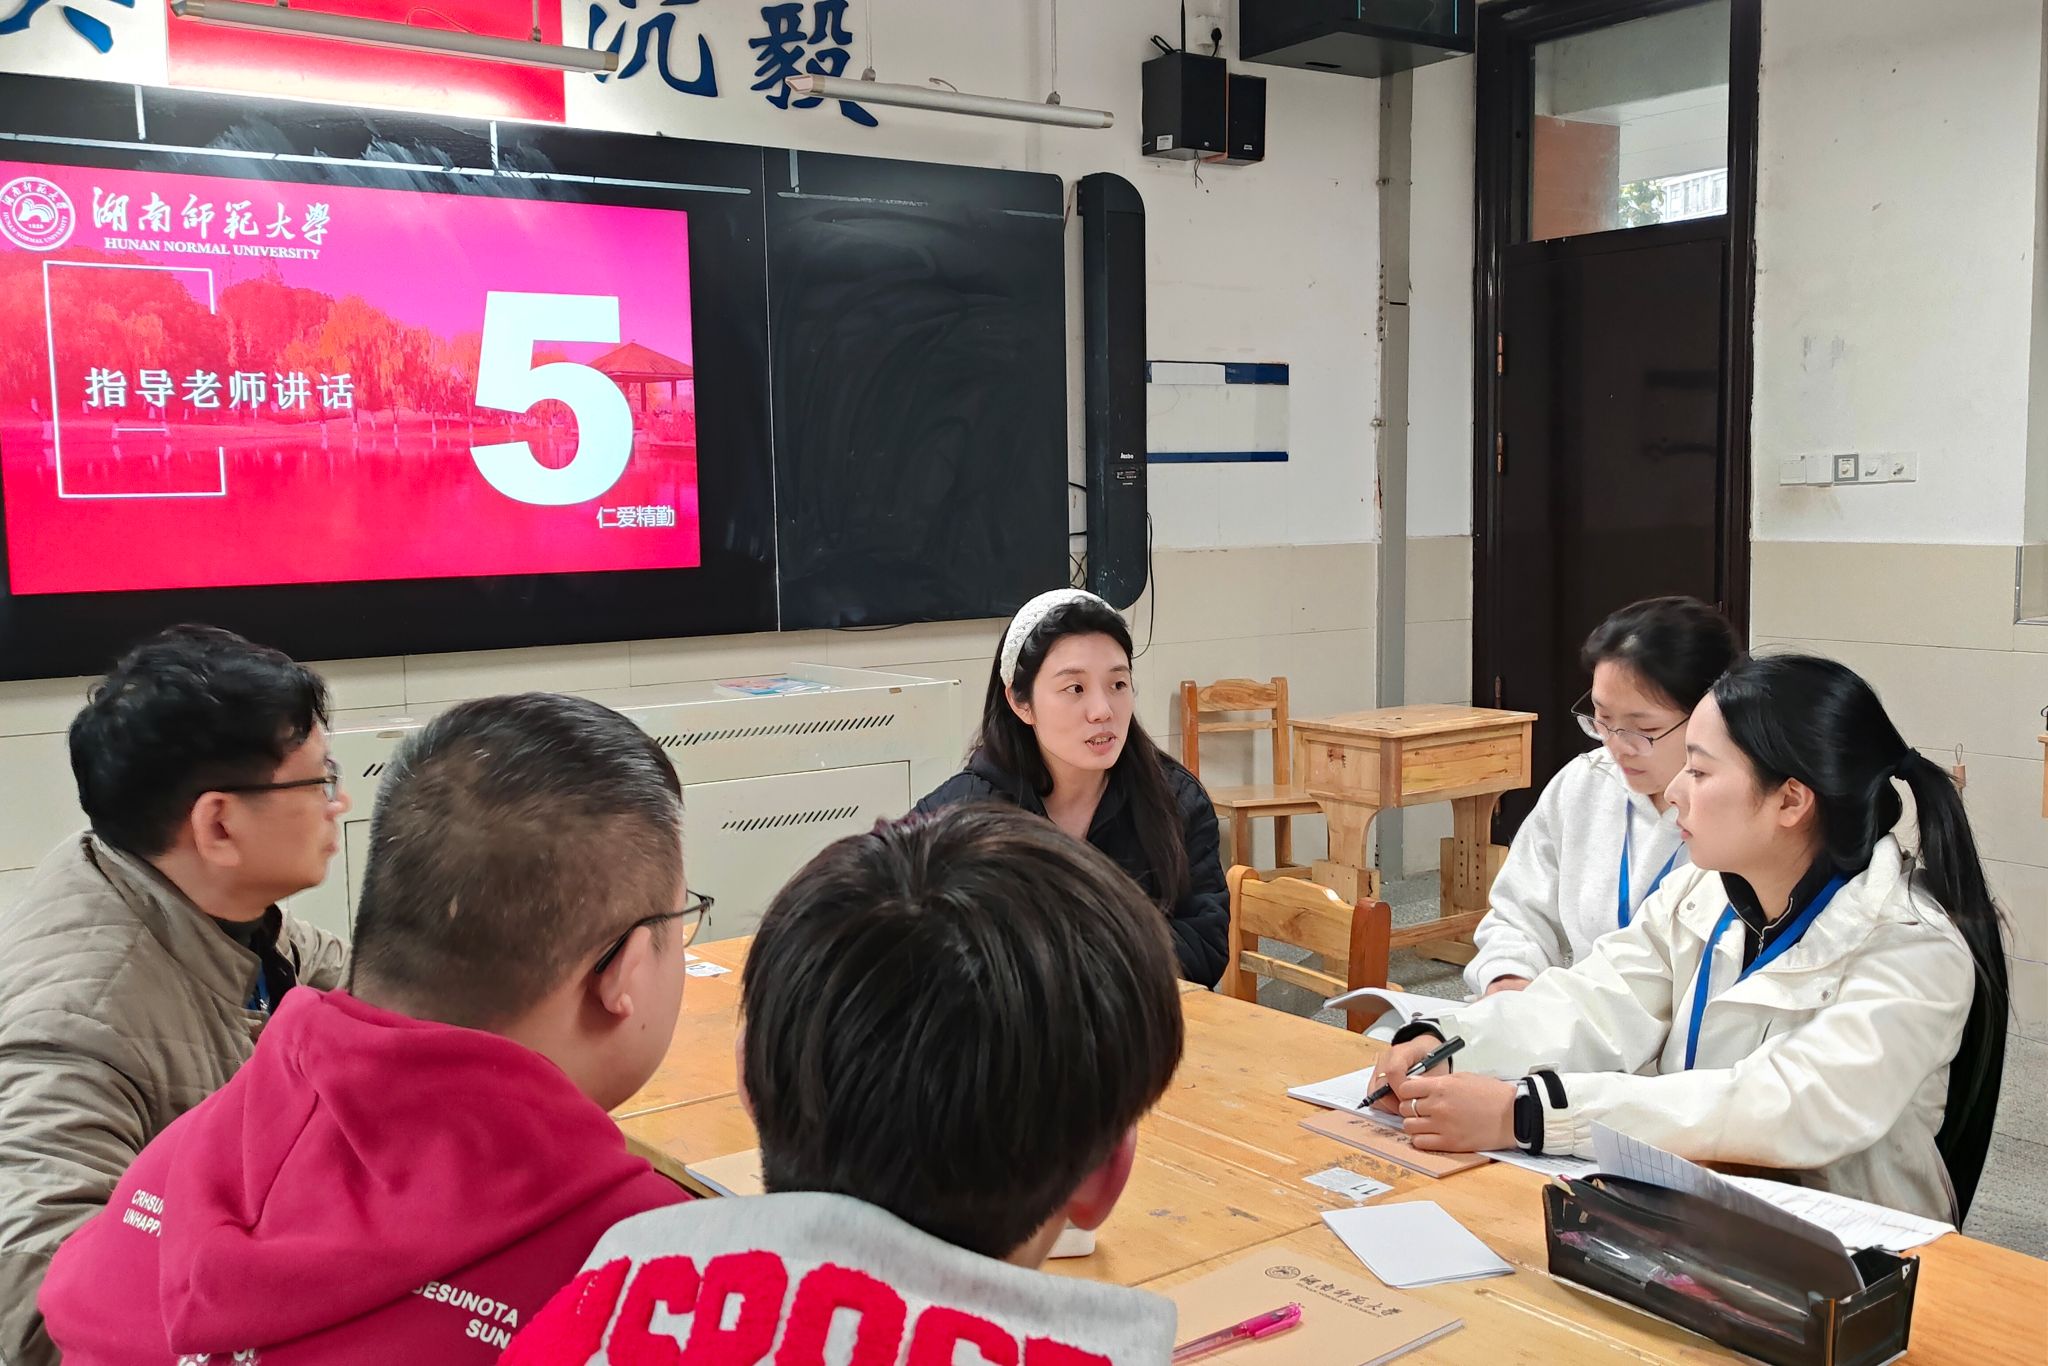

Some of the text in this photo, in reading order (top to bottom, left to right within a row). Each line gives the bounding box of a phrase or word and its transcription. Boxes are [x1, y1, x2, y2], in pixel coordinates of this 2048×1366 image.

[103, 237, 321, 260] HUNAN NORMAL UNIVERSITY
[84, 367, 355, 410] 指导老师讲话
[469, 290, 635, 507] 5
[595, 505, 676, 529] 仁爱精勤
